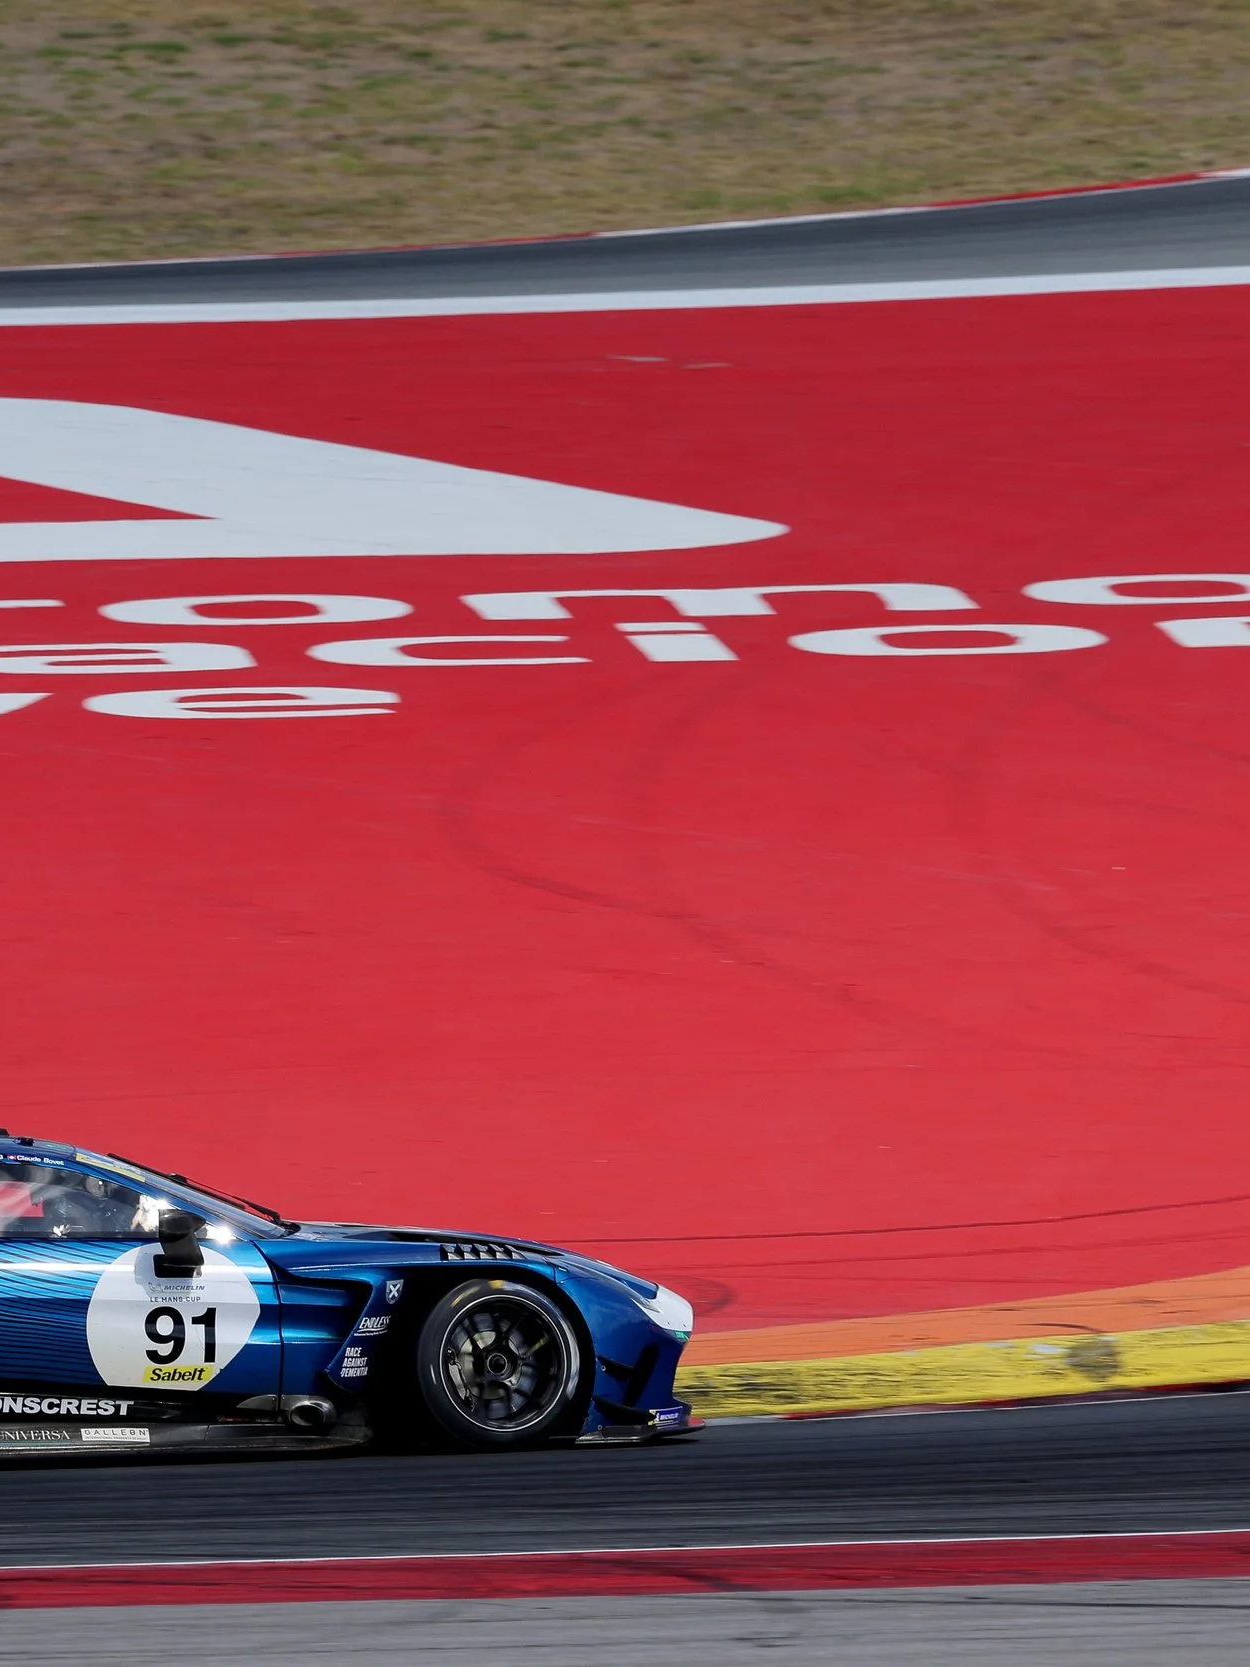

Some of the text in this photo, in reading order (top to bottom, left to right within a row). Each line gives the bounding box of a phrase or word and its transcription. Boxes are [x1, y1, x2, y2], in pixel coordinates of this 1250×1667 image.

[17, 1154, 41, 1163] Claude
[359, 1315, 392, 1329] ENDLESS
[144, 1305, 217, 1365] 91
[345, 1347, 362, 1357] RACE
[342, 1357, 368, 1367] AGAINST
[150, 1367, 206, 1381] Sabelt
[340, 1366, 368, 1377] DEMENTIA
